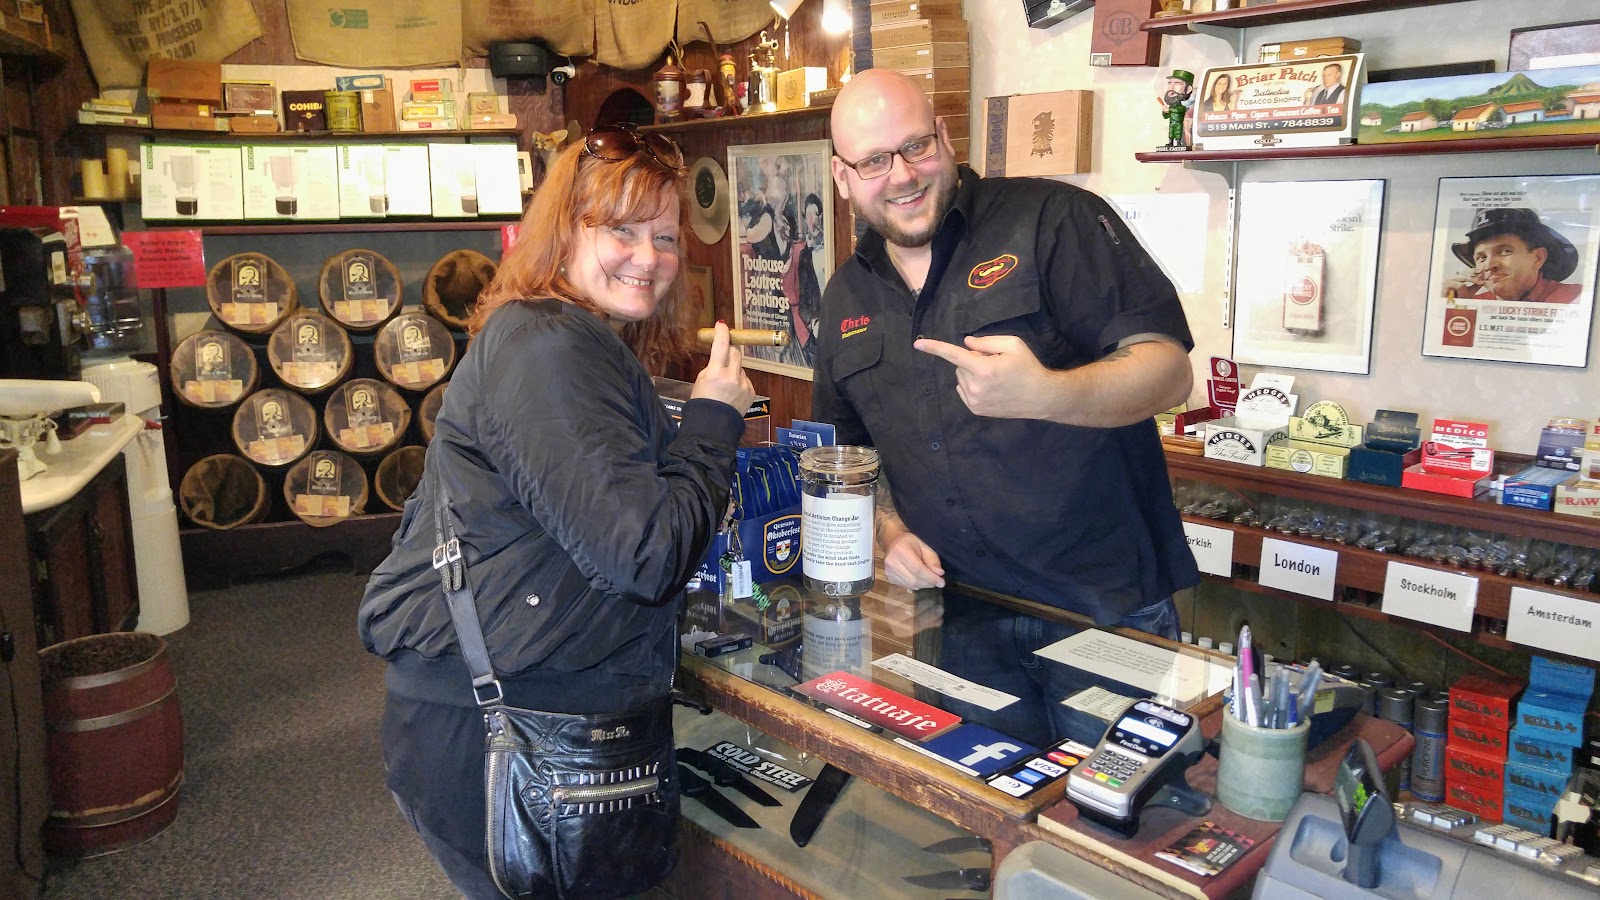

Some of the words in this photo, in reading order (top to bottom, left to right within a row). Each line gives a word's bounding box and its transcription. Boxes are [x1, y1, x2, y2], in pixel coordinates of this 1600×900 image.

[1235, 72, 1276, 88] Briar
[1278, 67, 1317, 83] Patch
[1253, 88, 1290, 97] Distinctive
[1274, 96, 1301, 104] SHOPPE
[1204, 113, 1228, 121] Tobacco
[1231, 112, 1247, 120] Pipes
[1250, 111, 1269, 120] Cigars
[1273, 109, 1300, 118] Gourmet
[1300, 108, 1321, 116] Coffee
[1327, 106, 1339, 114] Tea
[1281, 118, 1334, 128] 784-8839
[742, 254, 784, 273] Toulouse
[745, 272, 783, 290] Lautrec:
[745, 289, 790, 313] Paintings
[1498, 306, 1521, 315] LUCKY
[1523, 307, 1549, 316] STRIKE
[840, 314, 871, 332] Chris
[1248, 389, 1287, 404] HEDGES
[1435, 426, 1486, 437] MEDICO
[1212, 432, 1252, 448] HEDGES
[1565, 497, 1599, 506] RAW
[767, 526, 800, 541] Oktoberfest
[1274, 553, 1320, 576] London
[1400, 578, 1457, 600] Stockholm
[1527, 606, 1592, 628] Amsterdam
[838, 687, 937, 731] tatuaje
[591, 728, 615, 742] Miss
[615, 725, 630, 738] Me
[716, 743, 760, 764] COLD
[754, 761, 806, 786] STEEL
[1033, 761, 1062, 775] VISA
